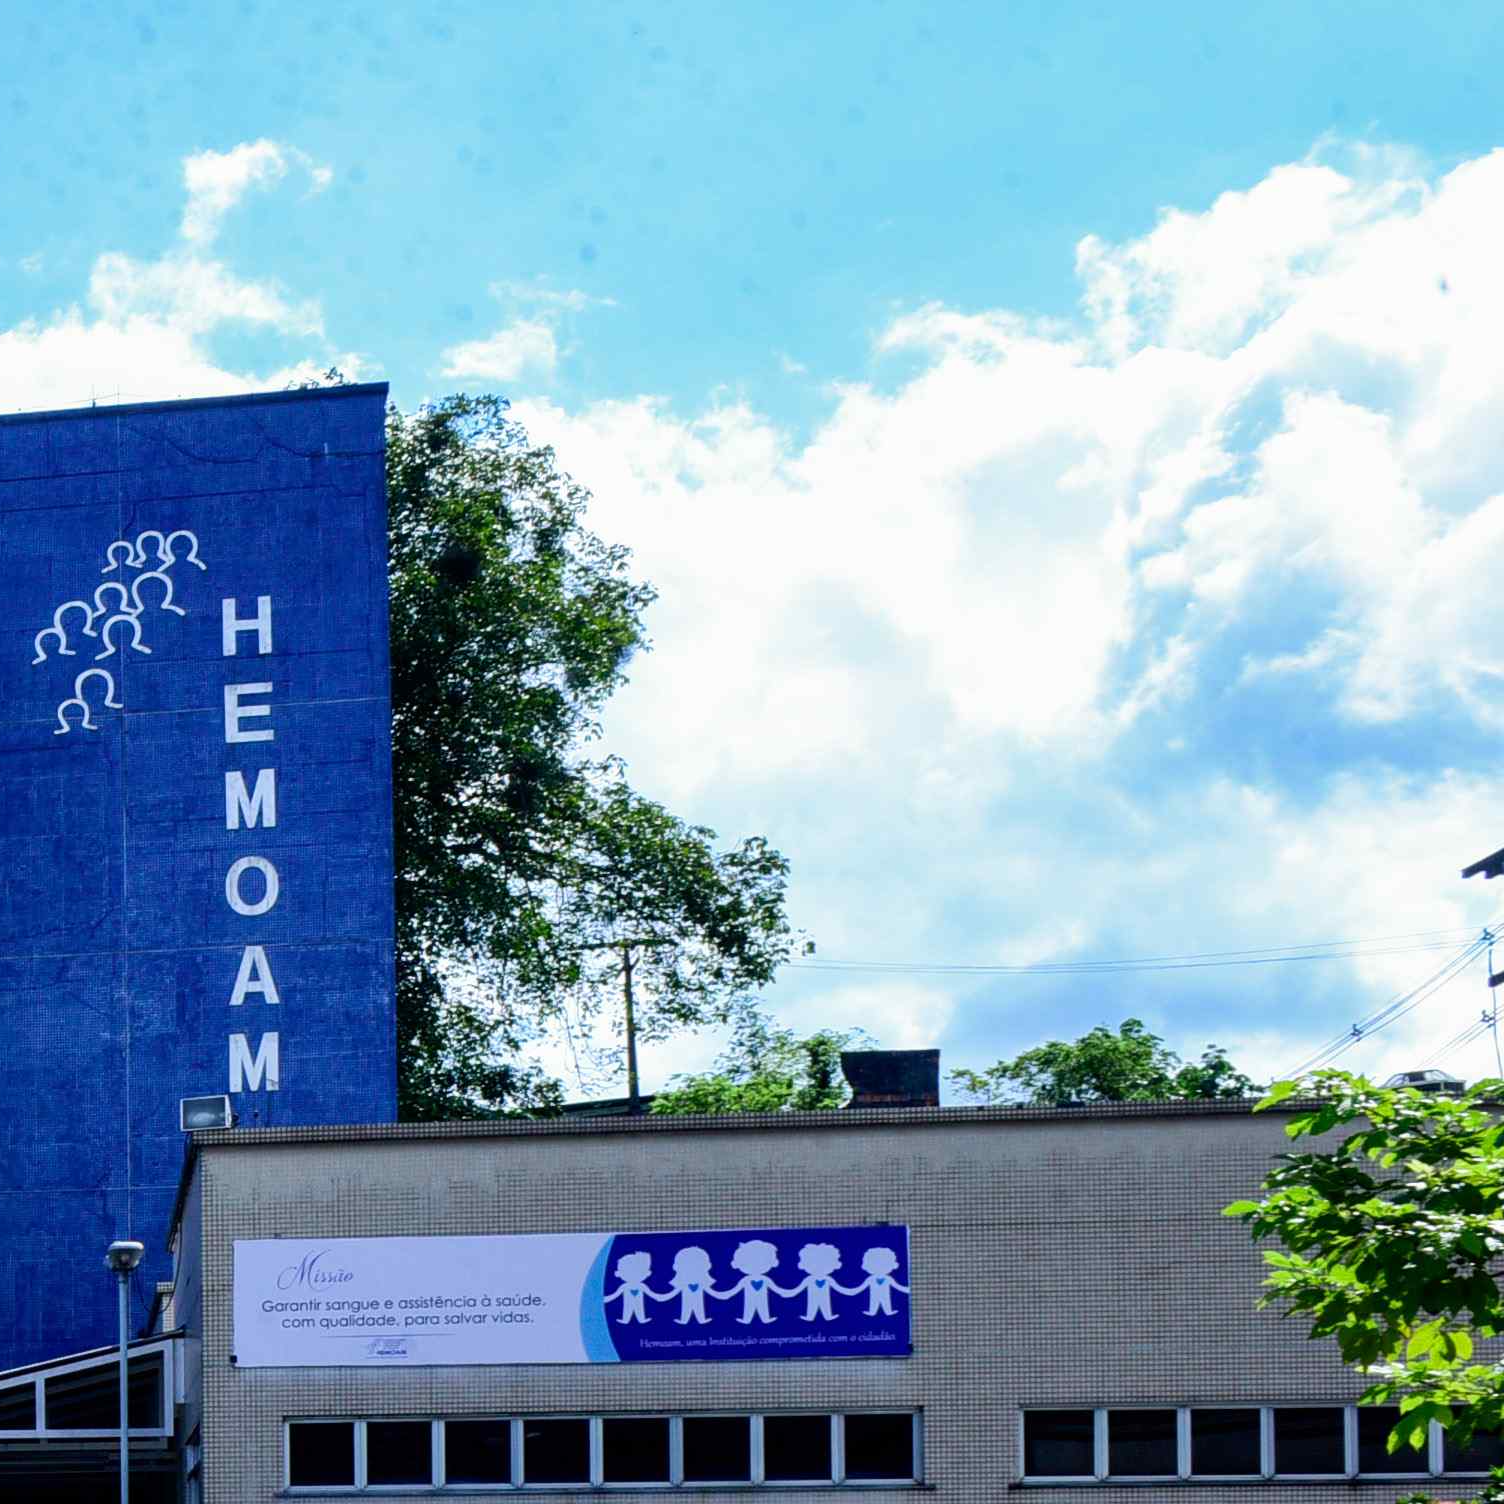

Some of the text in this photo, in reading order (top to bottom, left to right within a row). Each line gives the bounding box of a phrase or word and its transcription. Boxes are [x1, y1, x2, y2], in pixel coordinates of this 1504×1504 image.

[222, 595, 280, 1093] HEMOAM
[277, 1249, 353, 1292] Missão
[262, 1299, 321, 1312] Garantir
[325, 1299, 380, 1313] sangue
[384, 1299, 393, 1309] e
[398, 1296, 477, 1310] assistência
[481, 1294, 491, 1307] à
[282, 1318, 315, 1328] com
[404, 1315, 440, 1328] para
[444, 1312, 487, 1325] salvar
